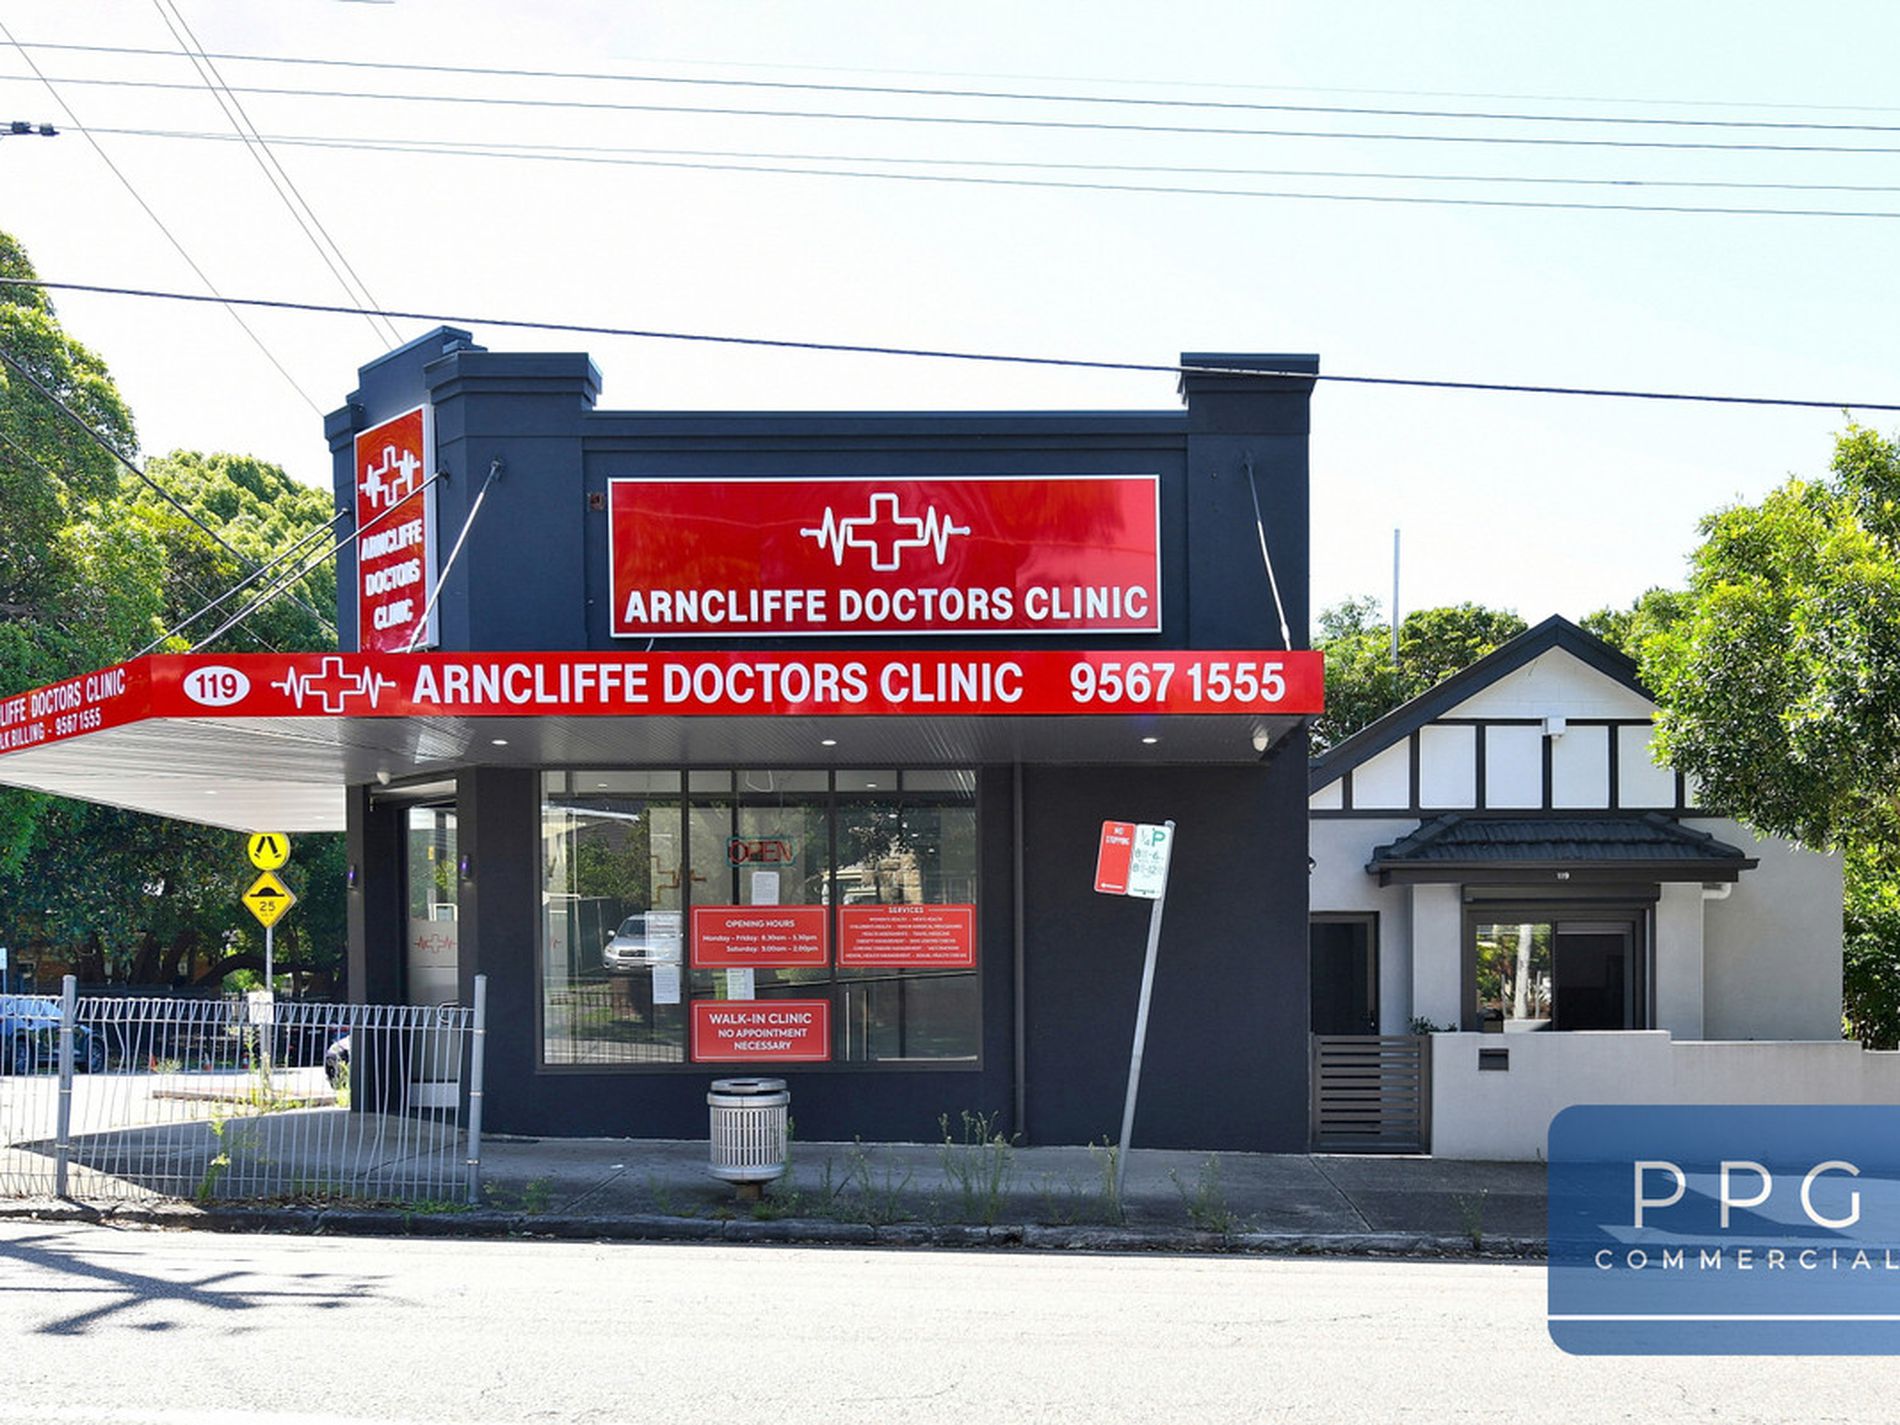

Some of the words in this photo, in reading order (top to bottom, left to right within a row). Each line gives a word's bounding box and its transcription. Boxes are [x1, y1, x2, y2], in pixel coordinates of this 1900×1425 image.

[365, 558, 421, 597] DOCTORS
[373, 599, 414, 630] CLINIC
[624, 589, 827, 623] ARNCLIFFE
[839, 587, 1013, 622] DOCTORS
[1024, 586, 1148, 620] CLINIC
[196, 674, 238, 698] 119
[413, 663, 648, 704] ARNCLIFFE
[663, 663, 869, 703] DOCTORS
[880, 662, 1024, 703] CLINIC
[1070, 662, 1176, 703] 9567
[1187, 662, 1287, 703] 1555
[0, 697, 27, 727] LIFFE
[31, 681, 82, 718] DOCTORS
[86, 668, 126, 703] CLINIC
[12, 722, 45, 747] BILLING
[55, 713, 78, 736] 9567
[79, 707, 101, 729] 1555
[729, 839, 793, 864] OPEN
[259, 901, 276, 912] 25
[888, 906, 924, 914] SERVICES
[725, 919, 765, 928] OPENING
[766, 919, 796, 928] HOURS
[703, 935, 730, 943] Monday
[709, 1013, 765, 1024] WALK-IN
[768, 1013, 812, 1024] CLINIC
[718, 1028, 735, 1038] NO
[736, 1028, 808, 1038] APPOINTMENT
[734, 1041, 791, 1051] NECESSARY
